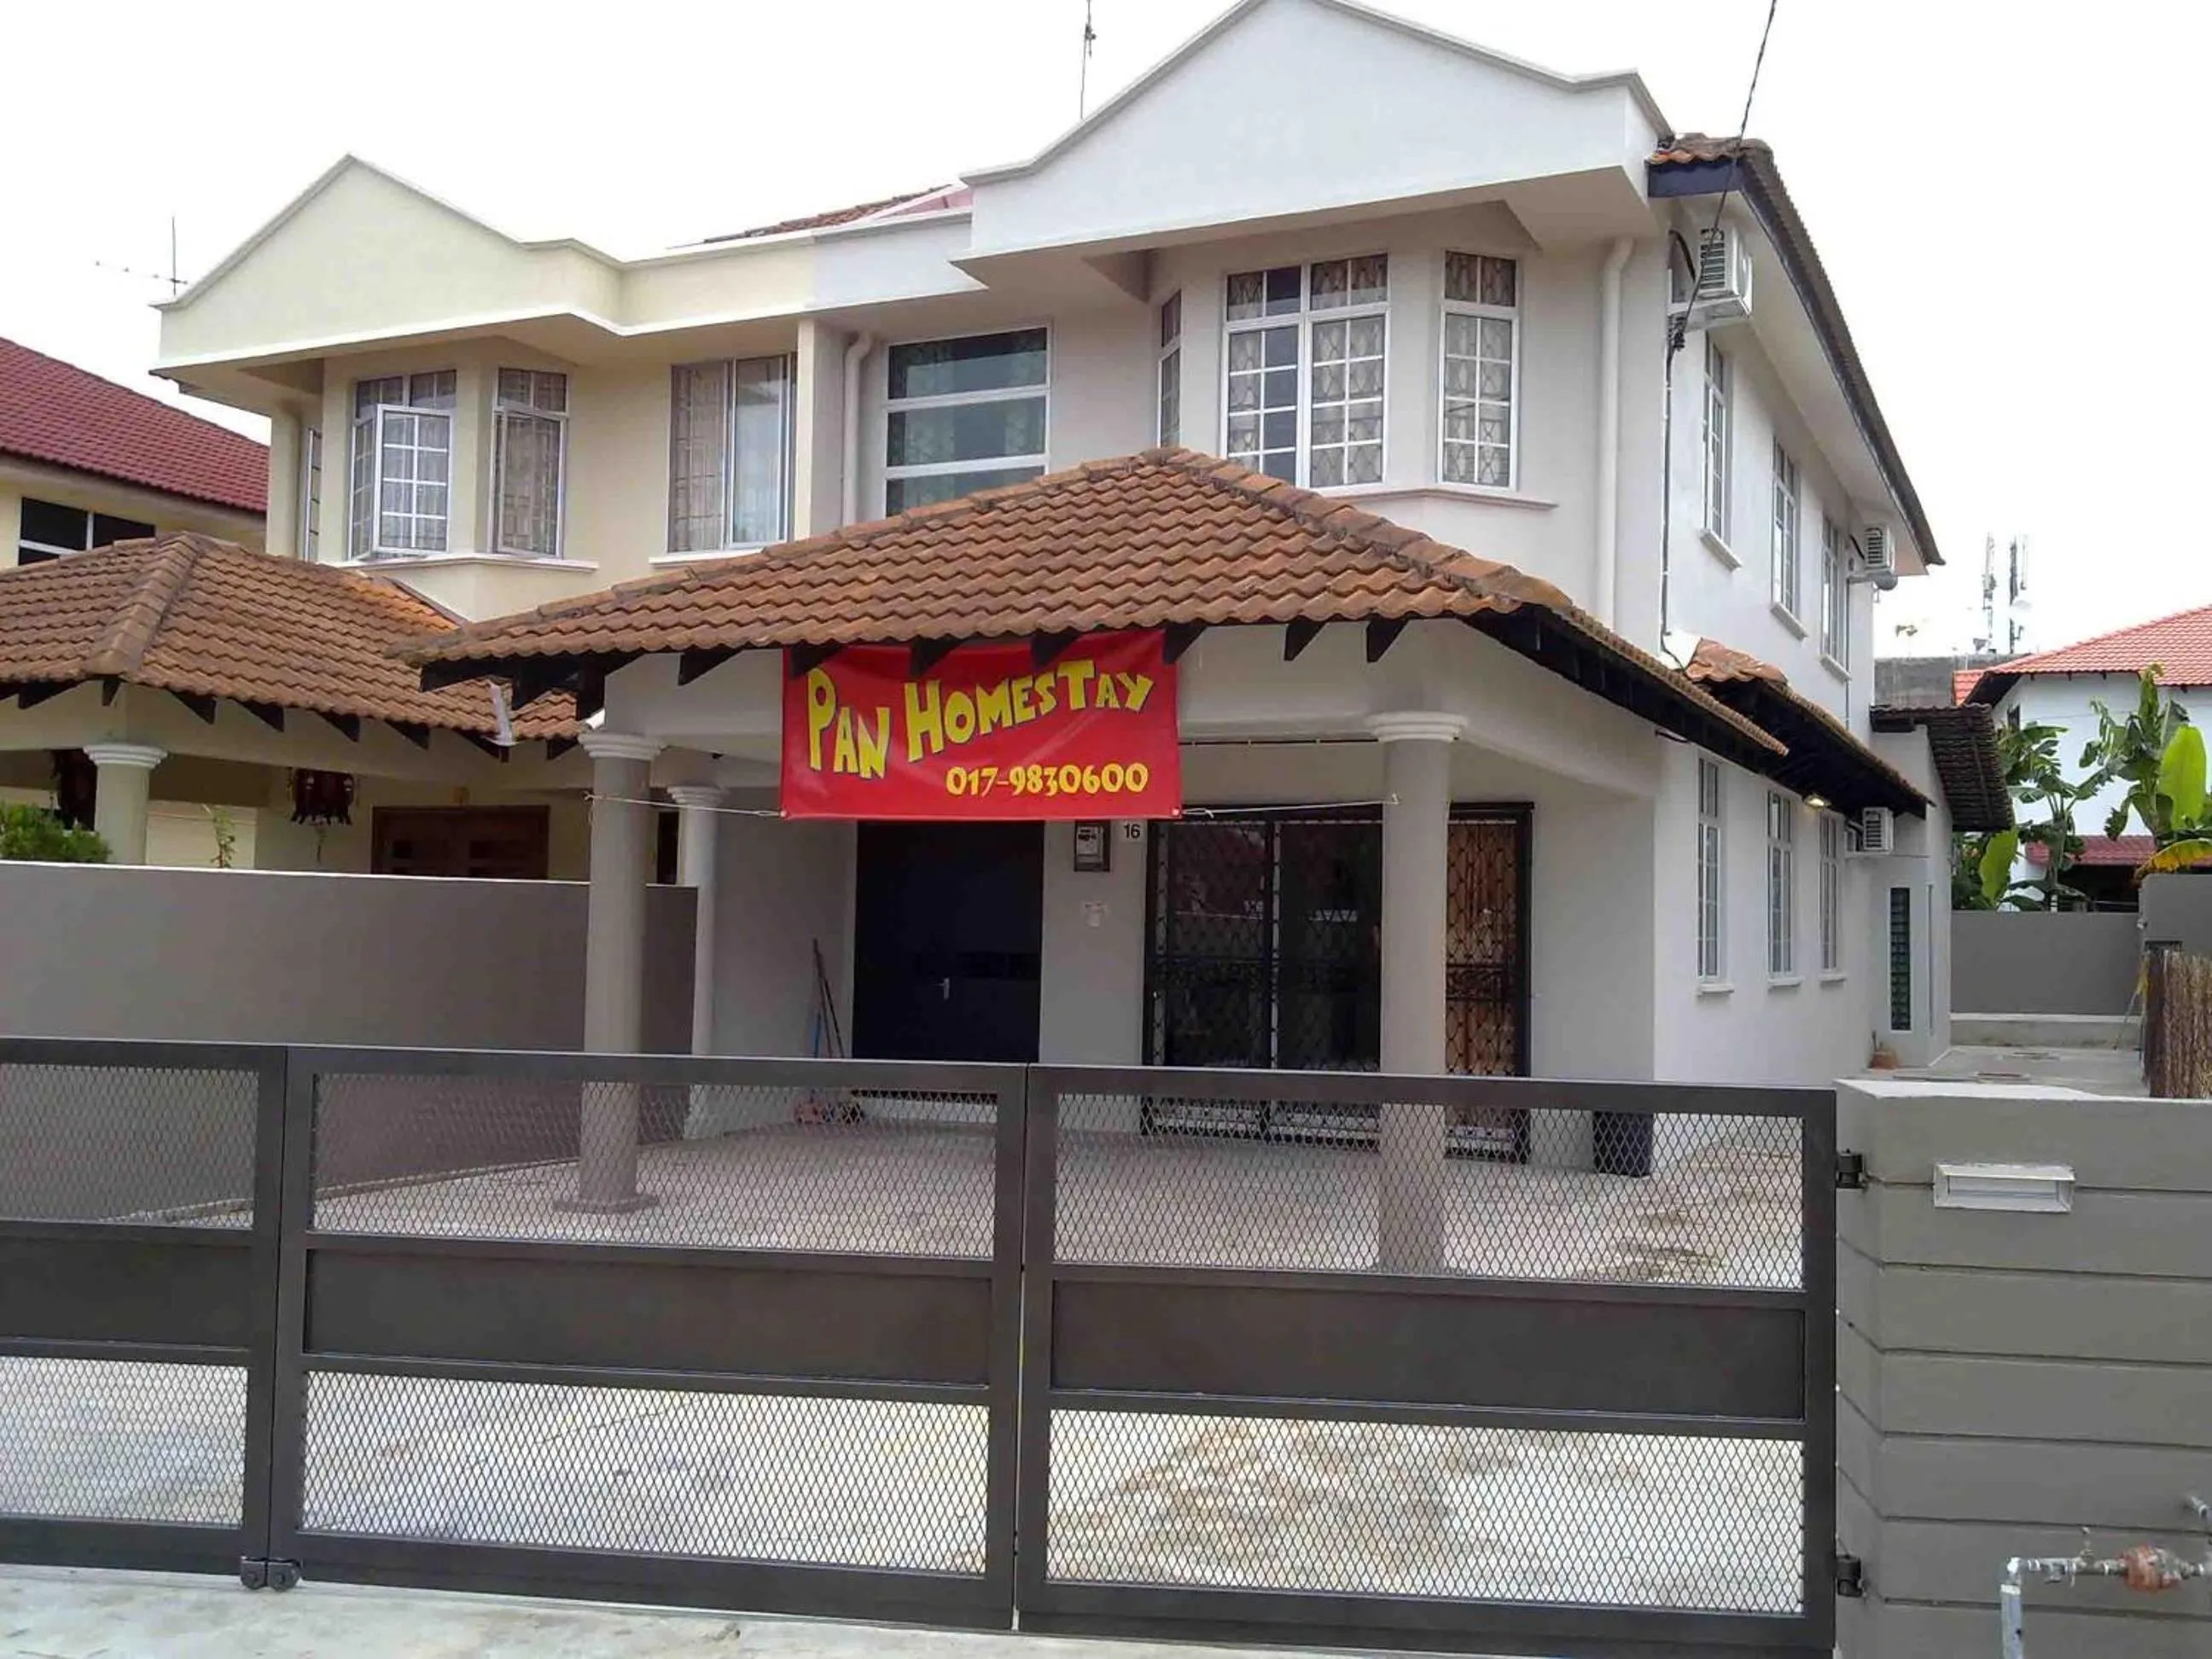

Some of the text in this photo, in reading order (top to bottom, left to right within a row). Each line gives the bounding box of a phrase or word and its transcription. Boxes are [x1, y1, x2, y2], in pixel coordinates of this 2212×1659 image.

[807, 661, 1153, 778] PAN HOMESTAY
[946, 764, 1149, 796] 017-9830600
[1123, 824, 1141, 839] 16
